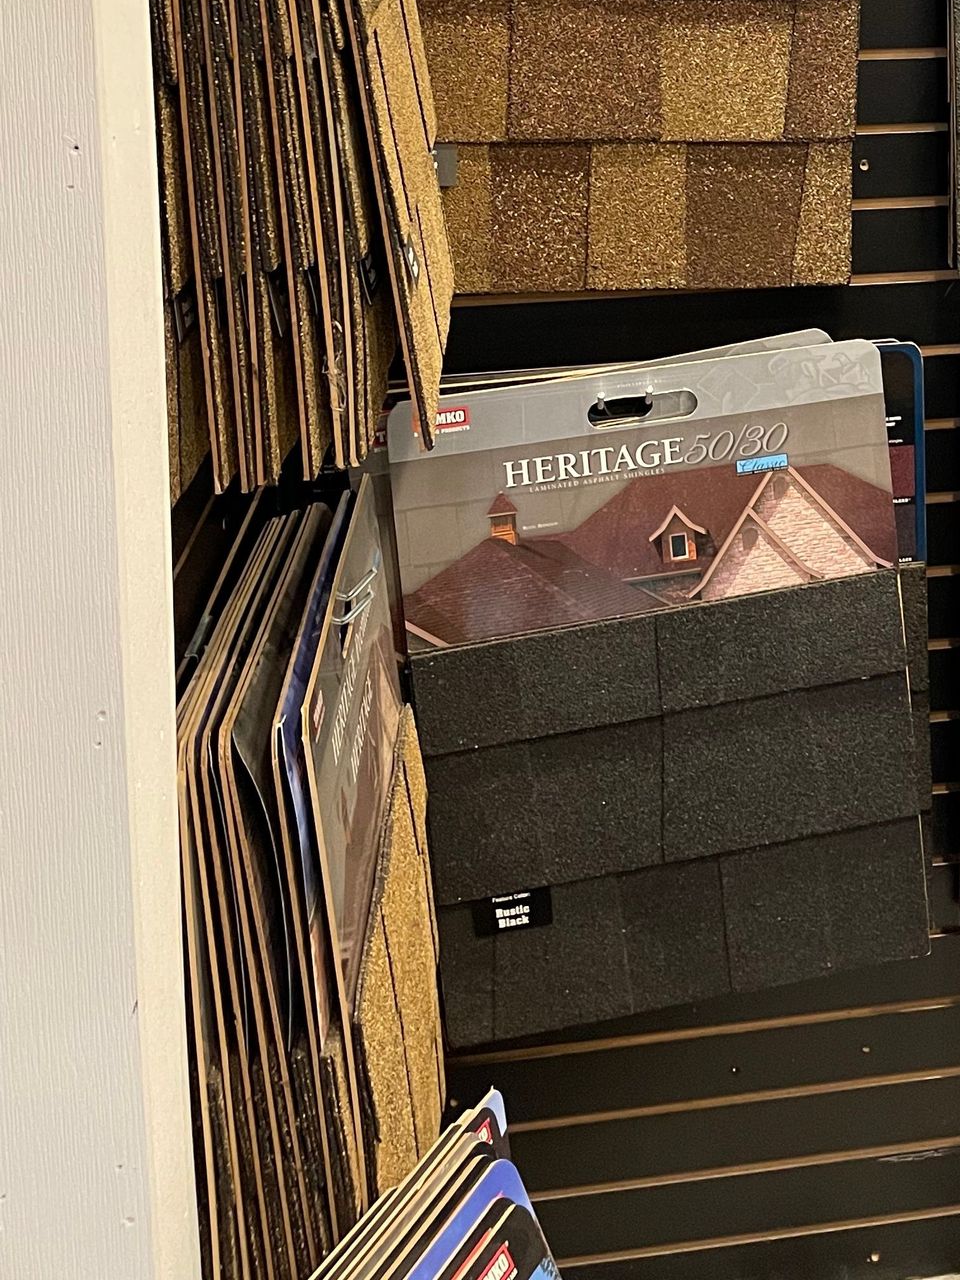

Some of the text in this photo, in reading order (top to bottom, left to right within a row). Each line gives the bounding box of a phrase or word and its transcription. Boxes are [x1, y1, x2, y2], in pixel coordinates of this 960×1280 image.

[435, 410, 465, 425] MKO
[503, 422, 789, 489] HERITAGE 50/30
[528, 468, 666, 493] LAMINATED ASPHALT SHINGLES
[495, 904, 530, 918] Rustic
[498, 915, 530, 929] Black
